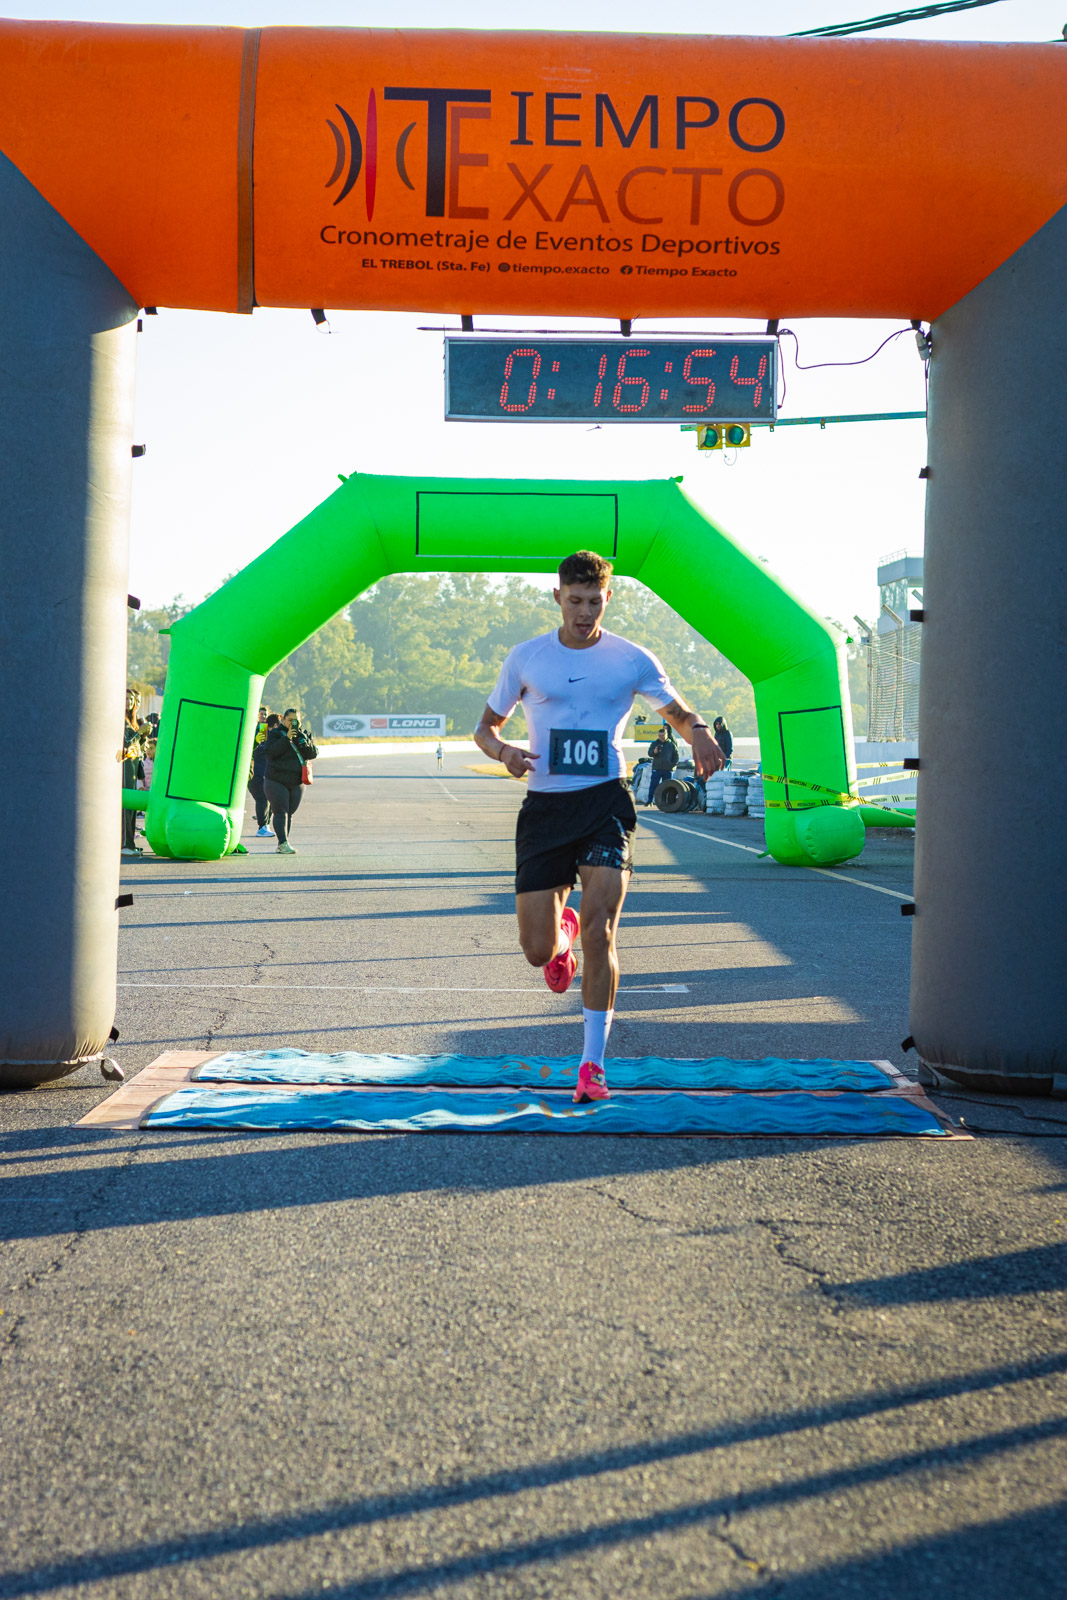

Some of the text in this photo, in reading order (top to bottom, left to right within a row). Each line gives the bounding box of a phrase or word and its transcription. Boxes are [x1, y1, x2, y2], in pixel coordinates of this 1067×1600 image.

[320, 225, 780, 257] Cronometraje de Eventos Deportivos
[362, 258, 737, 277] EL TREBOL (Sta. Fe) tiempo.exacto Tiempo Exacto
[500, 349, 766, 412] 0:16:54
[333, 719, 437, 730] Ford LONG
[563, 739, 599, 766] 106
